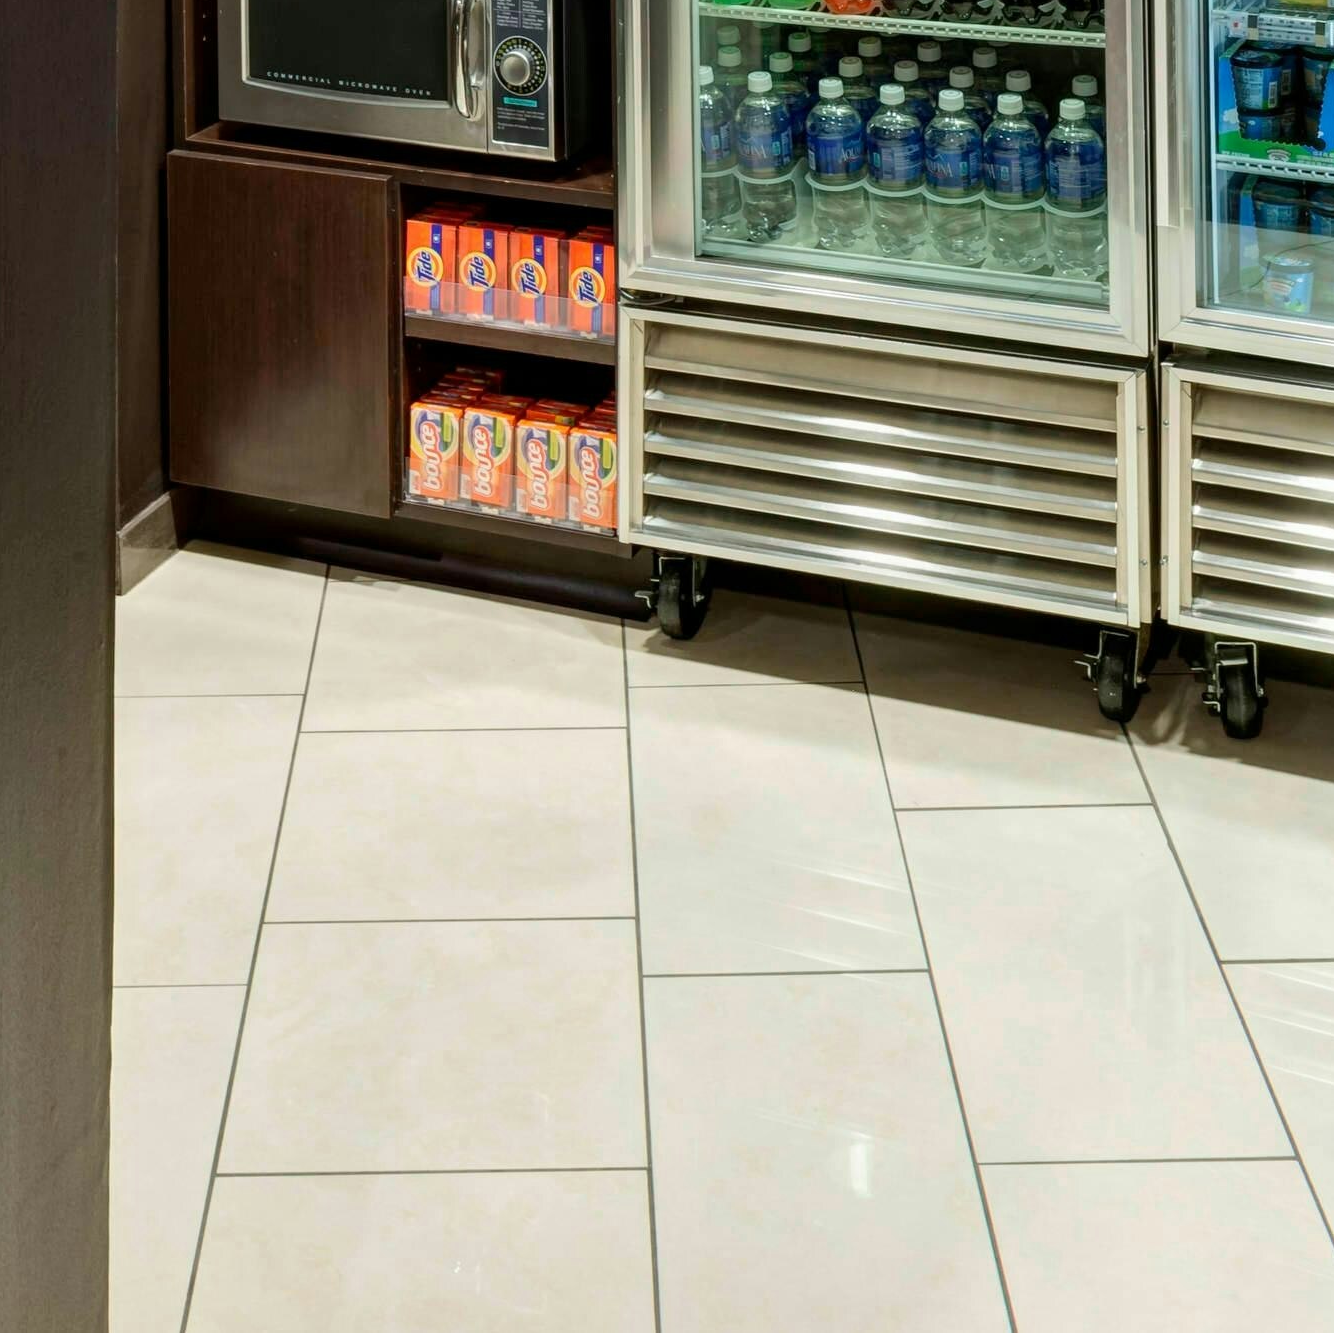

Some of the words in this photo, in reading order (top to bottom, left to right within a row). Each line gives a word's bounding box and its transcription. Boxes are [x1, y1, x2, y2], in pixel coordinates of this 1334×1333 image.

[267, 71, 331, 85] COMMERCIAL
[338, 80, 398, 93] MICROWAVE
[405, 88, 432, 97] OVEN
[417, 250, 436, 283] Tide
[469, 256, 489, 289] Tide
[520, 262, 541, 296] Tide
[577, 270, 598, 304] Tide
[419, 422, 443, 491] bounce
[472, 425, 495, 497] bounce
[526, 439, 549, 510] bounce
[579, 446, 603, 519] bounce
